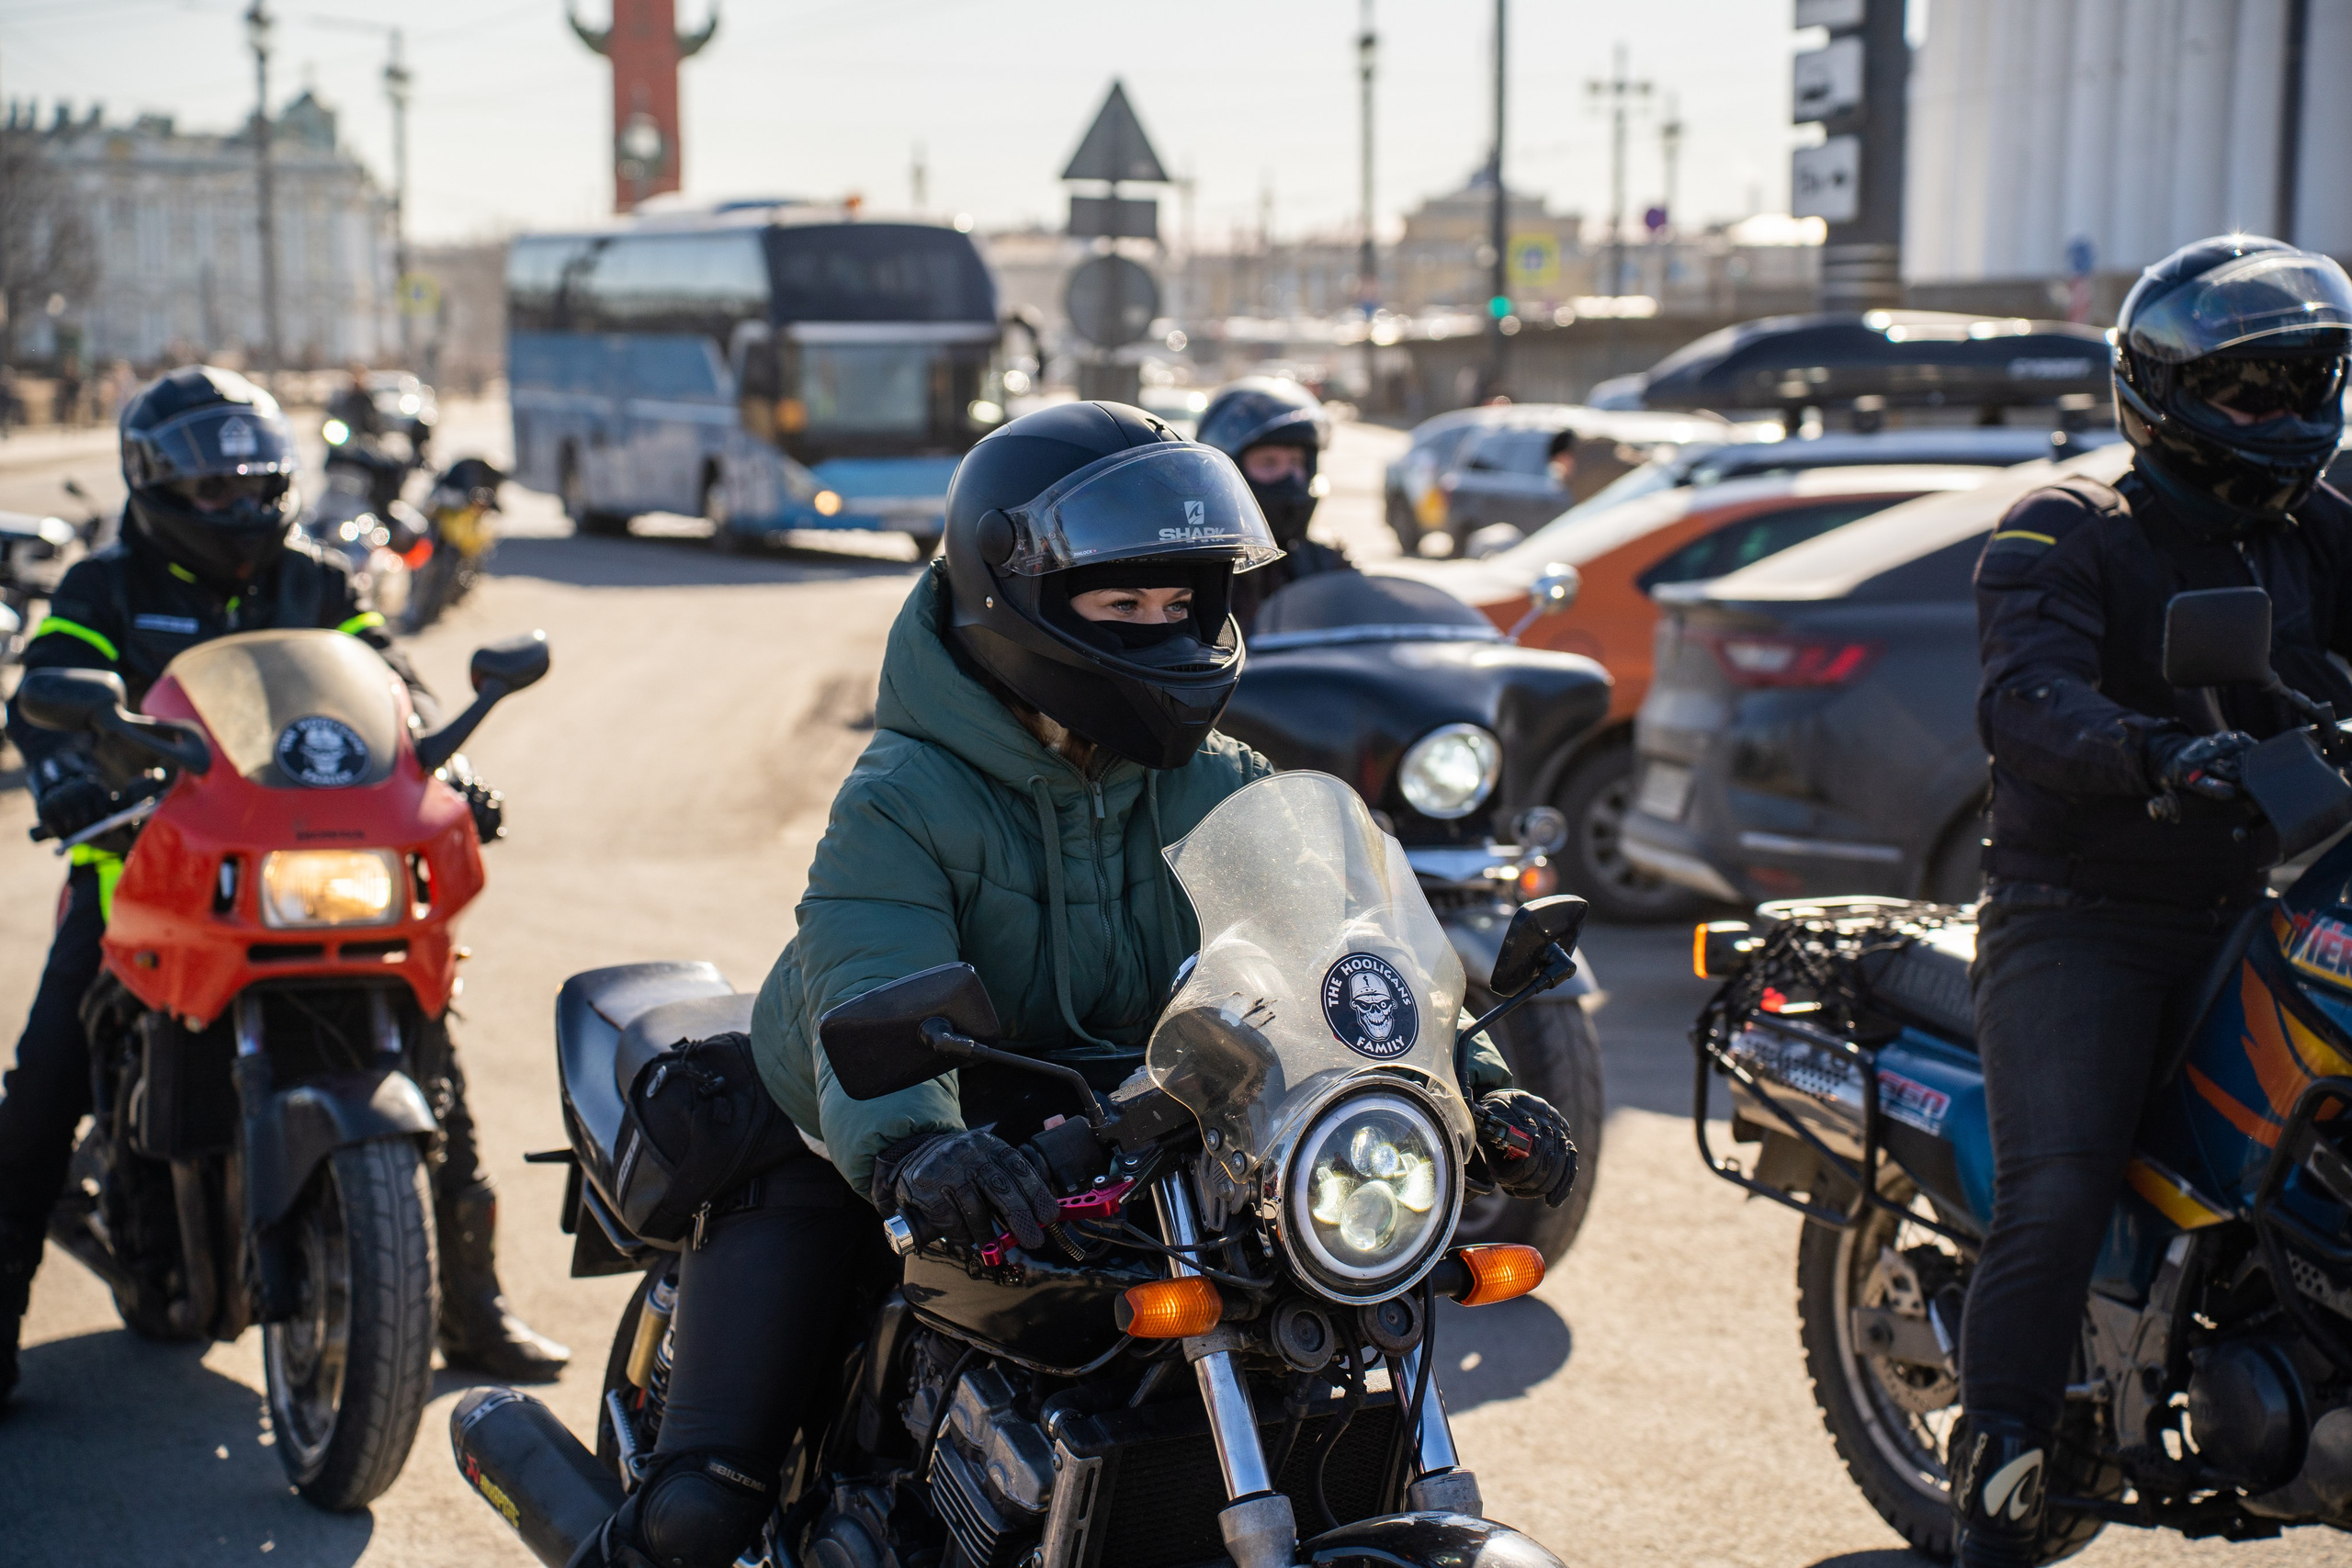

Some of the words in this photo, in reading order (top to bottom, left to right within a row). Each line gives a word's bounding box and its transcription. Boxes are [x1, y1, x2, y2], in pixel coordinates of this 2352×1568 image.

[1159, 527, 1225, 543] SHARK
[1328, 977, 1342, 1008] THE
[1340, 959, 1411, 1006] HOOLIGANS
[1356, 1035, 1405, 1054] FAMILY
